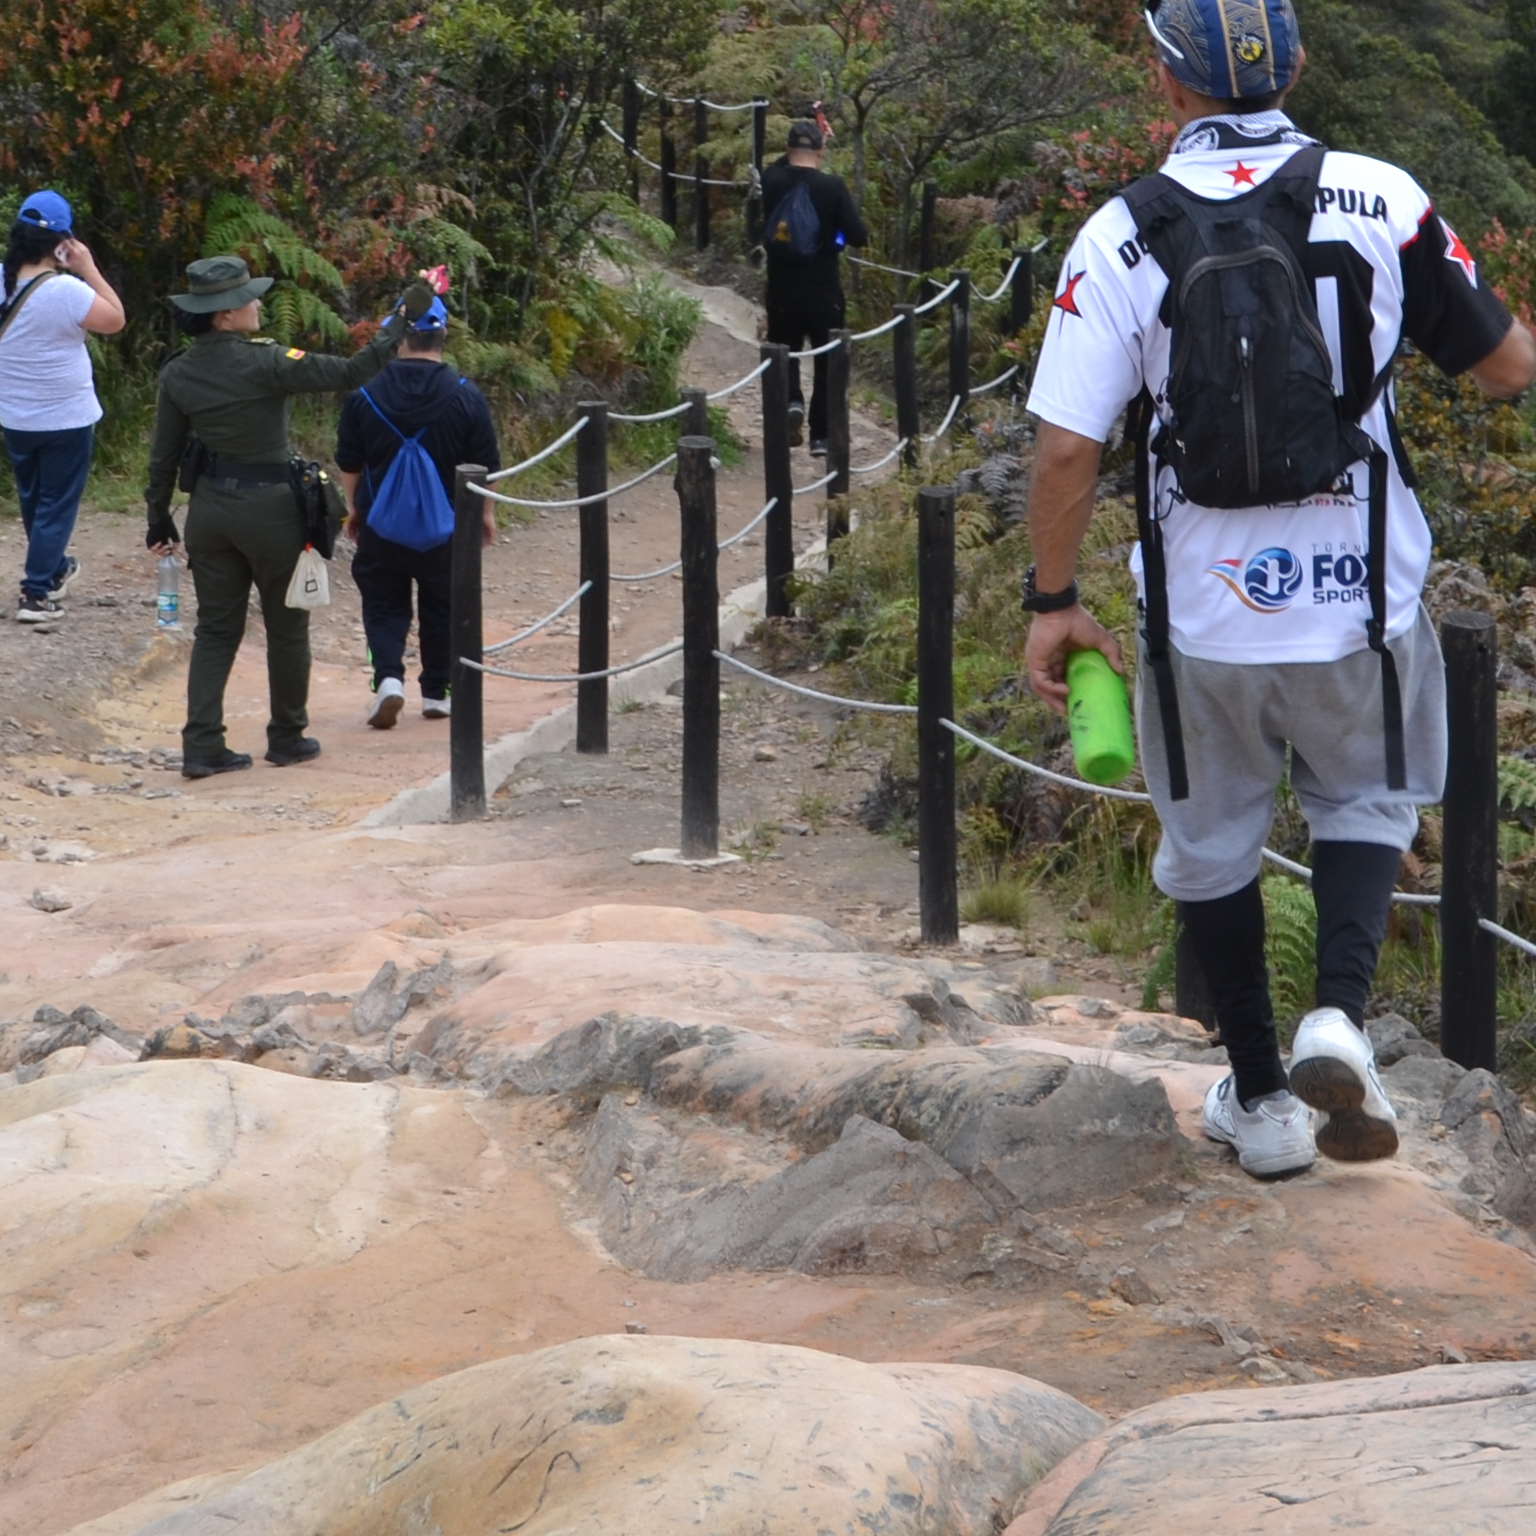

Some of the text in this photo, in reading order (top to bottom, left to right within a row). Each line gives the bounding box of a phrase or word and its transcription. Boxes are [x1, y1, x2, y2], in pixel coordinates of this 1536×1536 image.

[1313, 186, 1388, 225] PULA
[1312, 542, 1362, 554] TORN
[1313, 588, 1369, 605] SPOR
